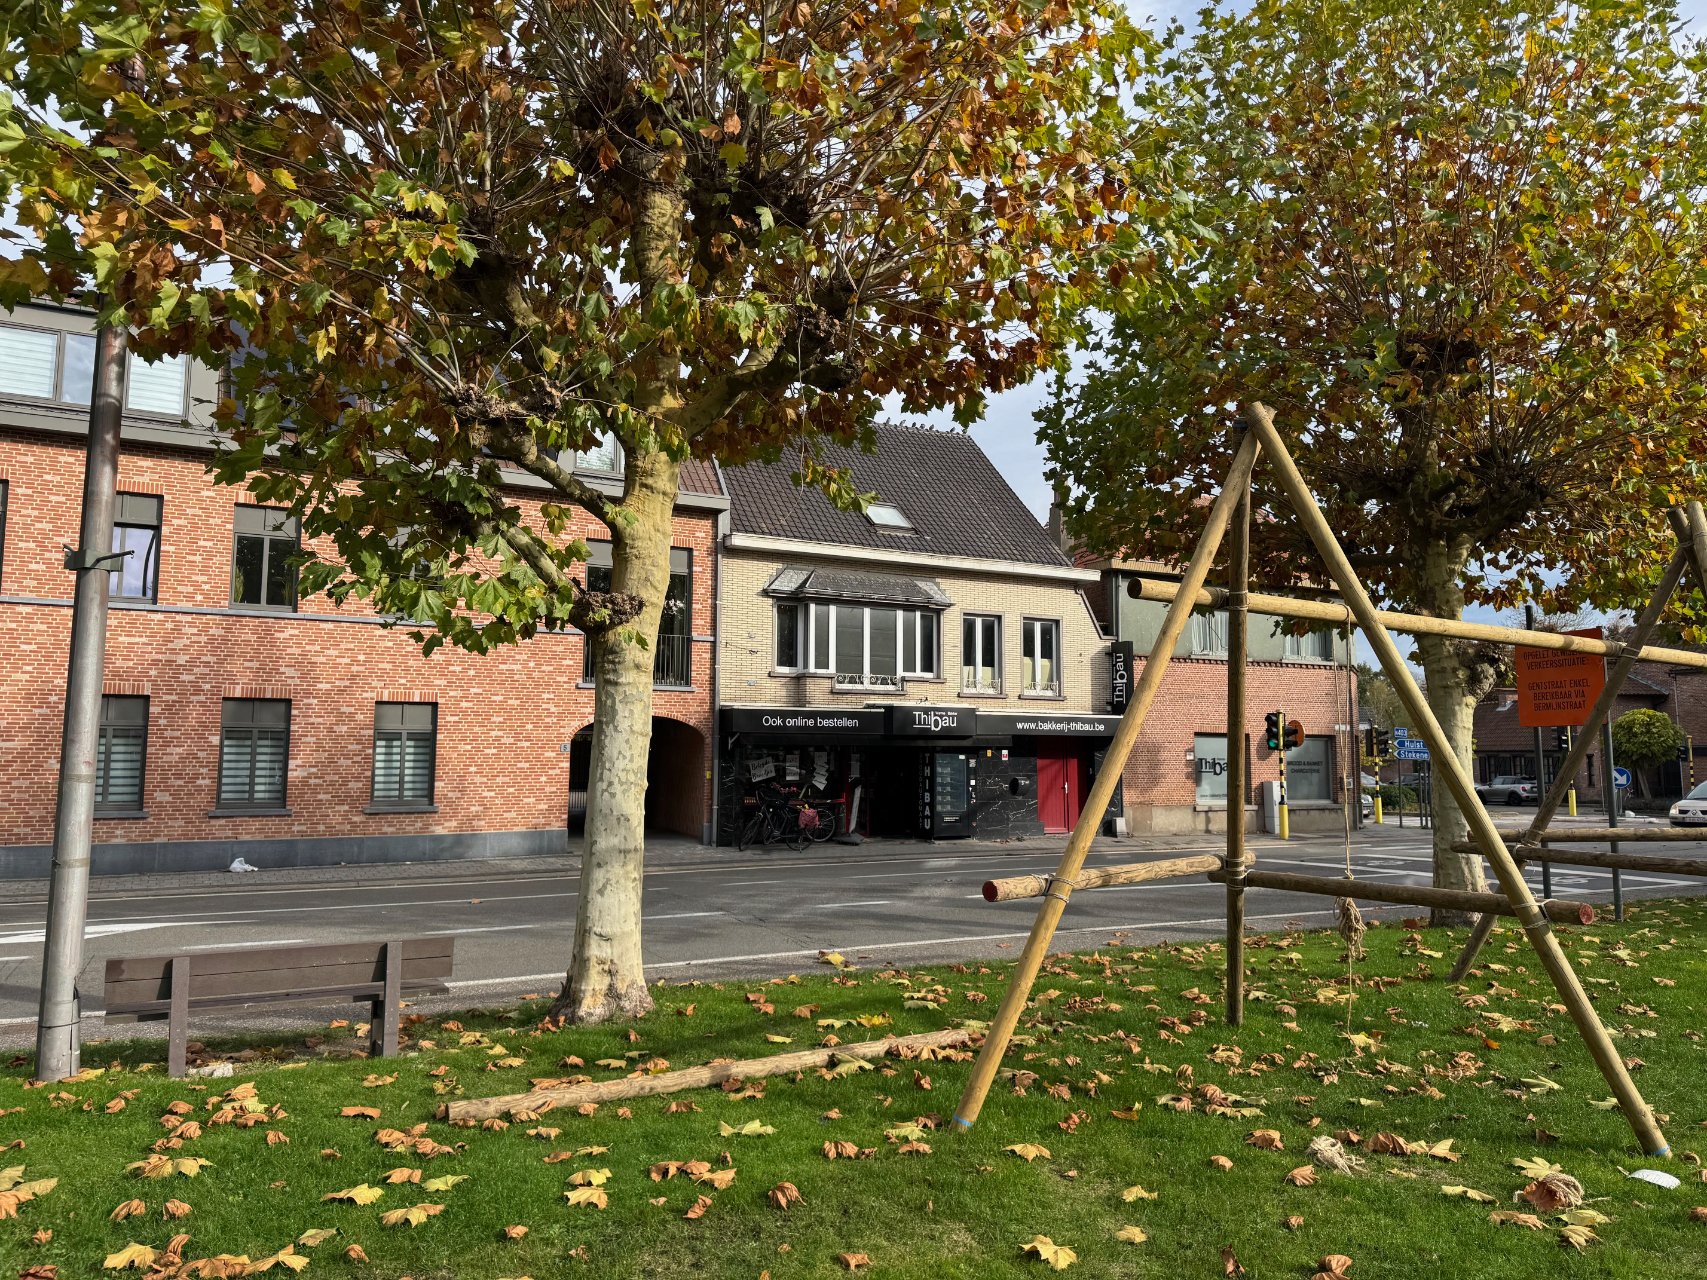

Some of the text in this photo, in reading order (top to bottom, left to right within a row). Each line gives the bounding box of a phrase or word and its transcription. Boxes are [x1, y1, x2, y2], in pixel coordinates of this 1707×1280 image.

[1523, 649, 1550, 660] OPGELET
[1526, 656, 1590, 670] VERKEERSSITUATIE:
[1113, 653, 1128, 705] Thibau
[1528, 678, 1590, 691] GENTSTRAAT ENKEL
[1533, 689, 1586, 701] BEREIKBAAR VIA
[1533, 700, 1587, 711] BERMIJNSTRAAT
[762, 715, 859, 727] Ook online bestellen
[912, 711, 957, 731] Thibau
[1016, 720, 1105, 732] www.bakkerij-thibau.be
[1404, 740, 1424, 748] Hulst
[1400, 750, 1428, 759] Stekene
[1198, 757, 1228, 776] Thiba
